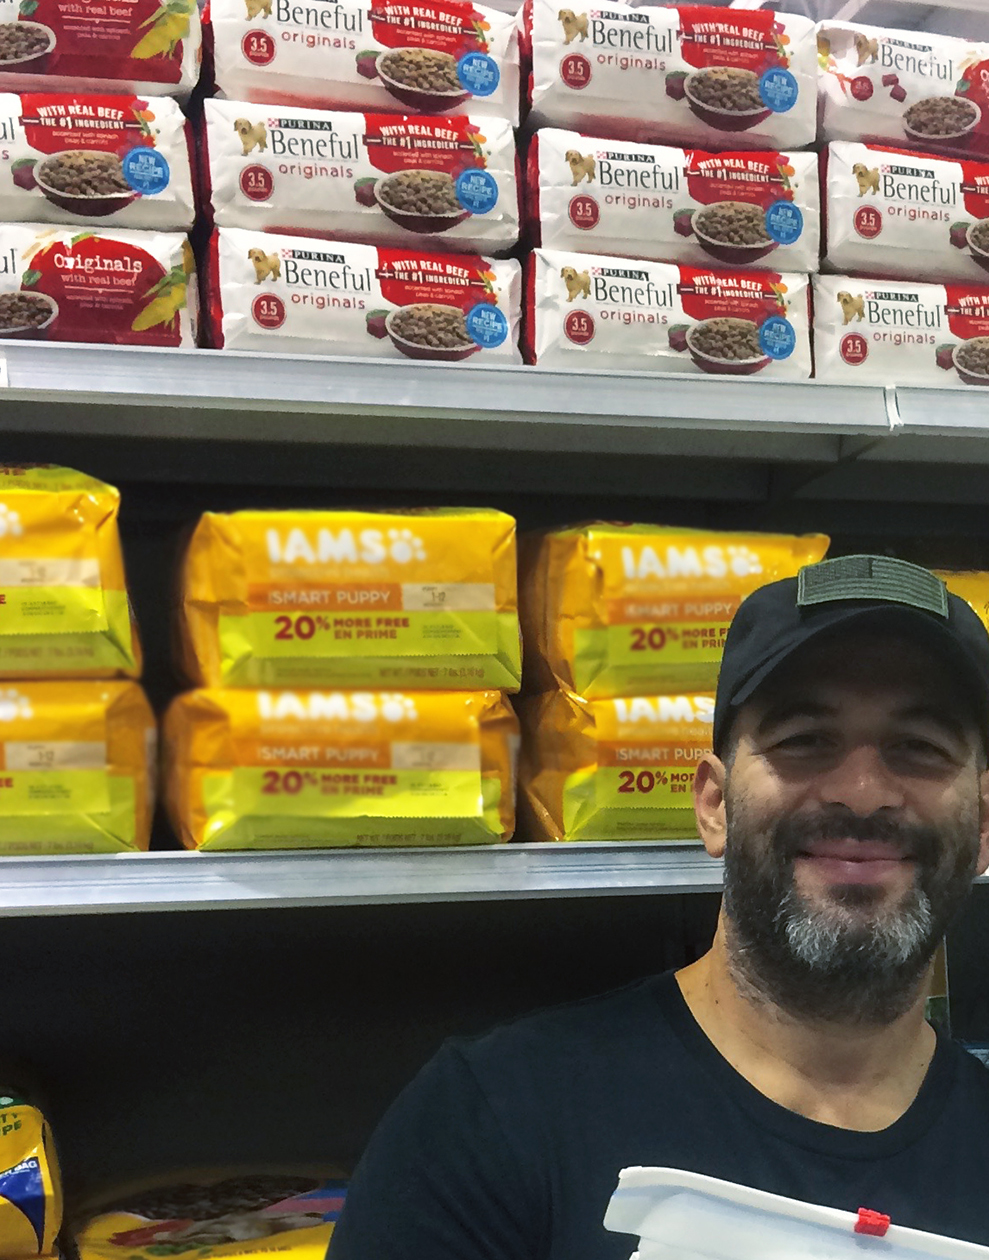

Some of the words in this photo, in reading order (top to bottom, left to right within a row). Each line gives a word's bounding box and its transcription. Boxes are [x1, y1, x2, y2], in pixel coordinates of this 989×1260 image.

[276, 0, 363, 33] Beneful
[592, 20, 673, 53] Beneful
[271, 129, 360, 160] Beneful
[600, 161, 679, 190] Beneful
[883, 175, 956, 205] Beneful
[54, 253, 143, 274] Originals
[284, 260, 372, 291] Beneful
[594, 277, 673, 307] Beneful
[868, 301, 941, 327] Beneful
[266, 528, 384, 564] IAMS
[622, 546, 728, 580] IAMS
[336, 591, 390, 604] PUPPY
[274, 615, 331, 640] 20%
[333, 618, 373, 628] MORE
[376, 617, 410, 628] FREE
[334, 630, 355, 640] EN
[360, 630, 397, 640] PRIME
[257, 692, 375, 721] IAMS
[617, 771, 668, 793] 20%
